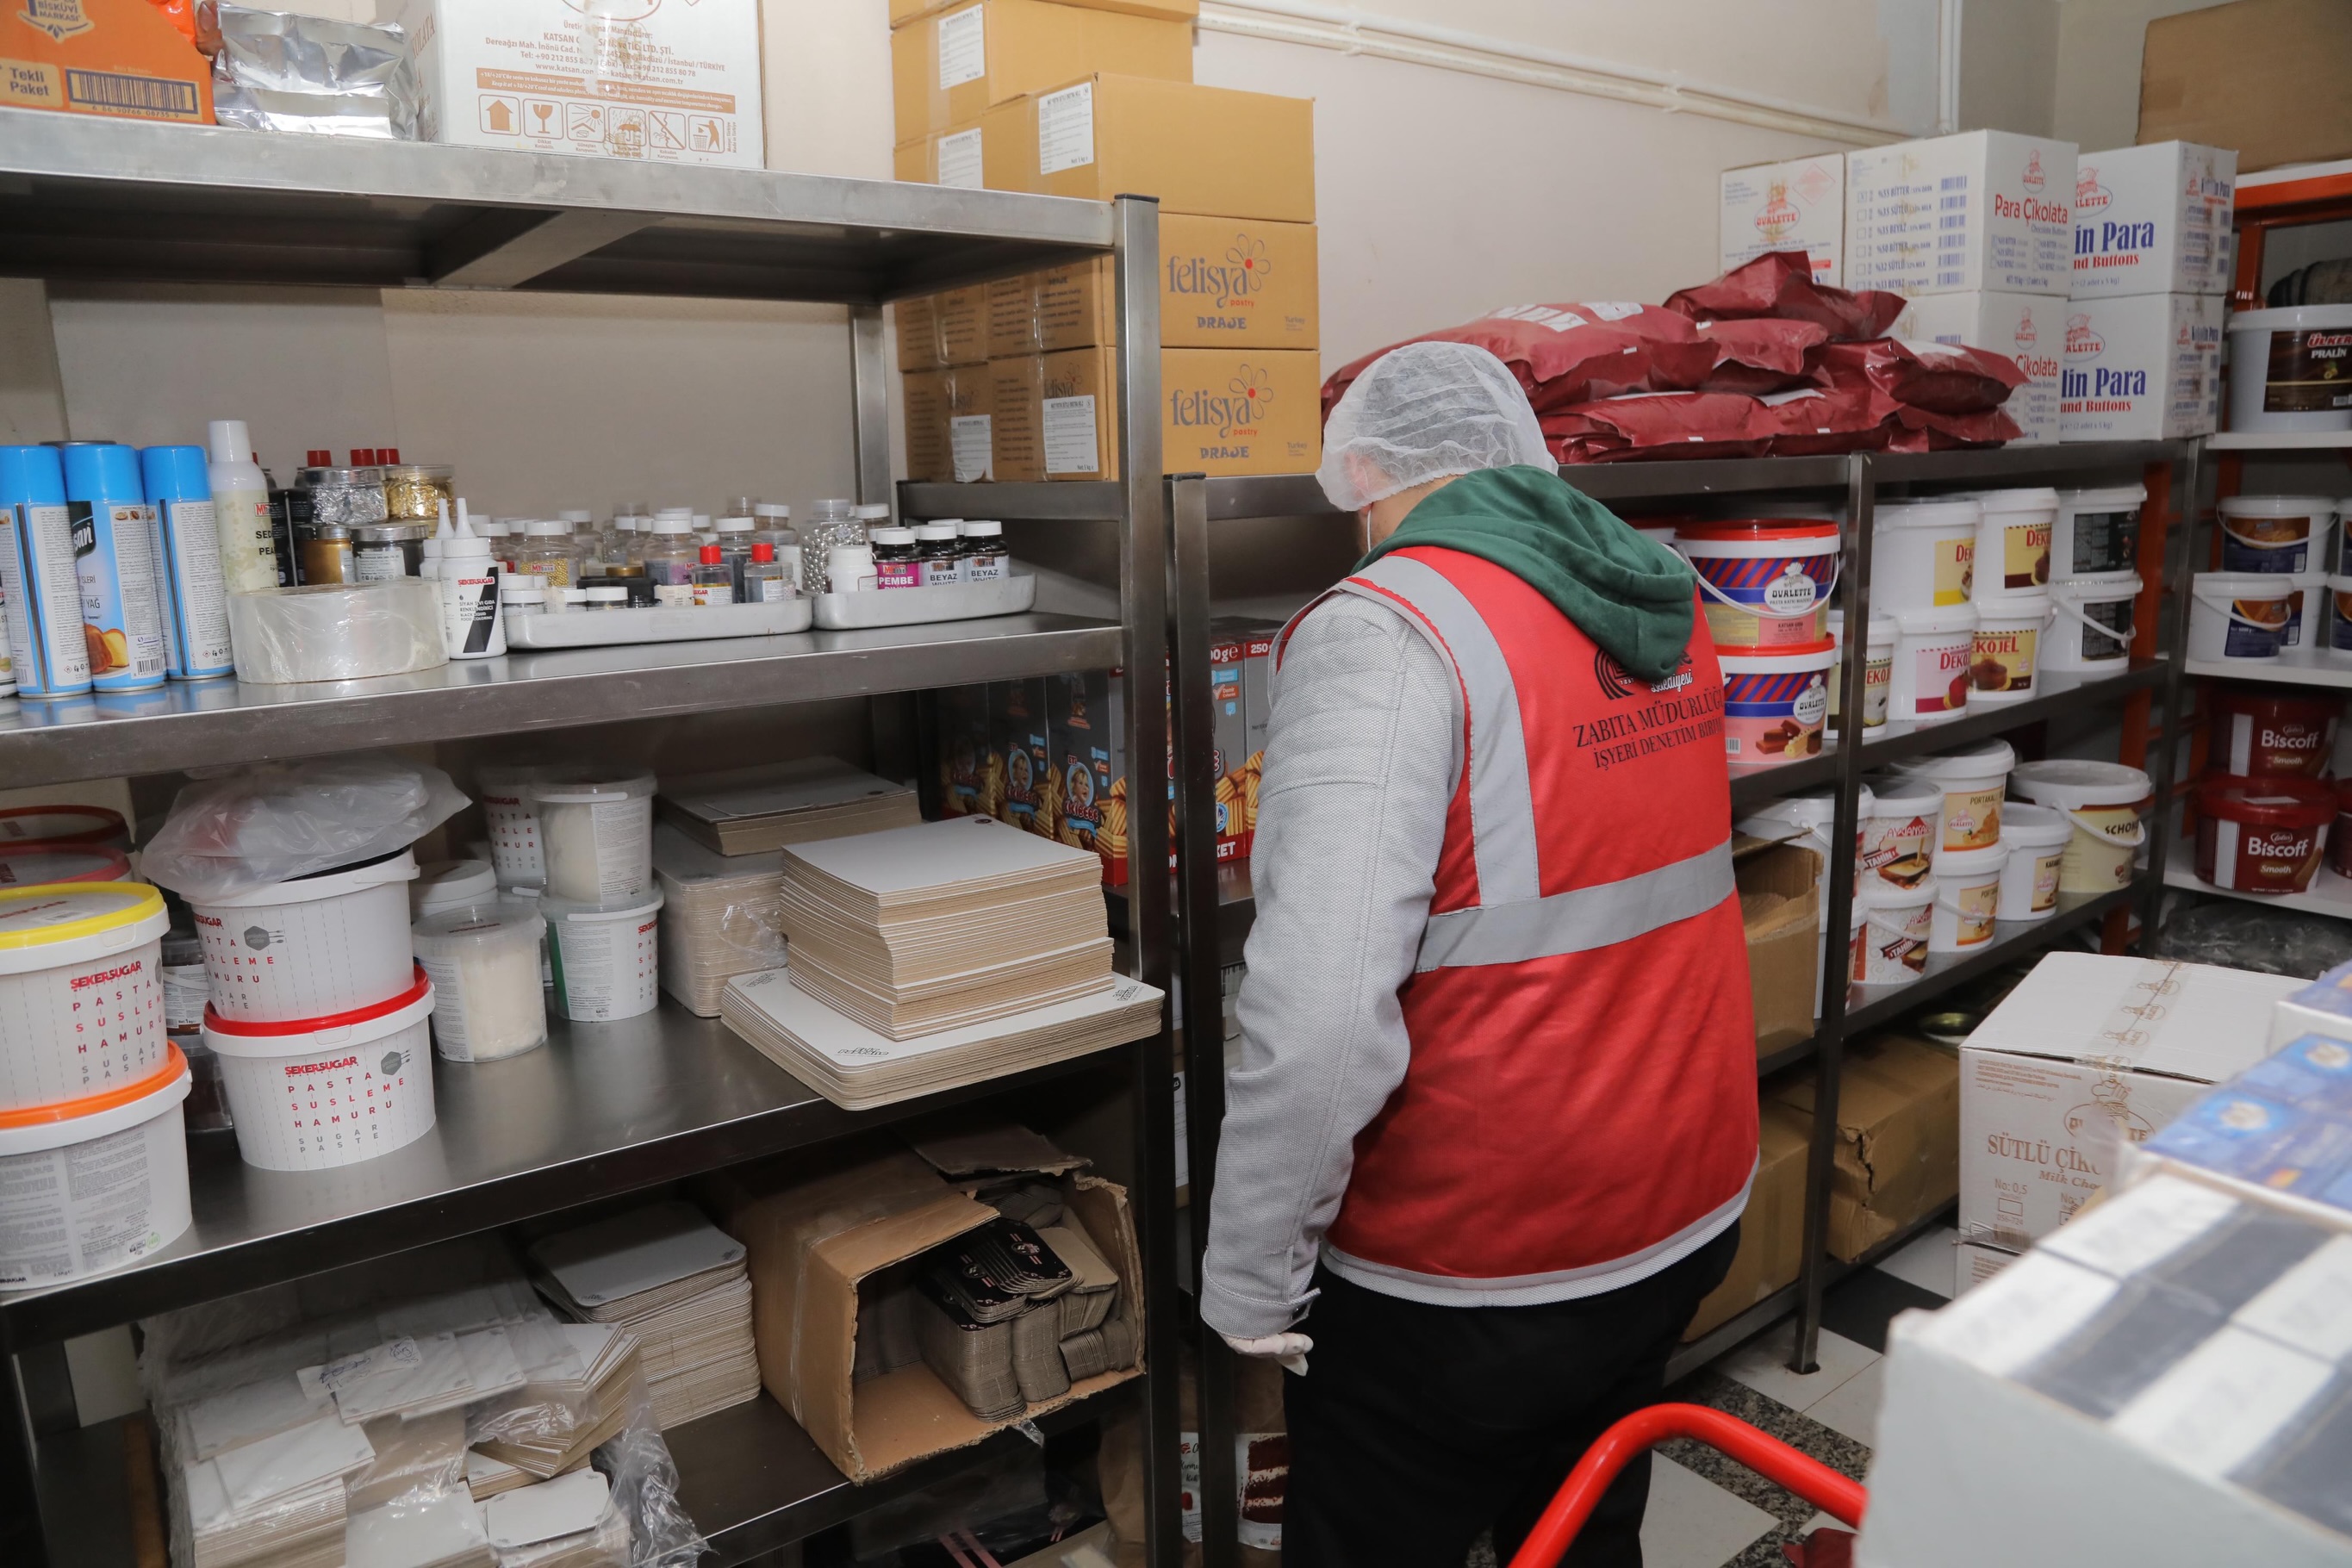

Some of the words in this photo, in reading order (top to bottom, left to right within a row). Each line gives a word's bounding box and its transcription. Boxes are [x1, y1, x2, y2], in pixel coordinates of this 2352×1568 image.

[544, 32, 575, 44] KATSAN
[486, 37, 517, 49] Dereağzı
[519, 41, 537, 50] Mah.
[538, 41, 559, 52] İnönü
[668, 56, 695, 68] İstanbul
[700, 60, 725, 72] TÜRKİYE
[520, 51, 533, 59] Tel:
[9, 67, 45, 83] Tekli
[10, 83, 49, 96] Paket
[1889, 185, 1910, 197] BİTTER
[2075, 196, 2108, 208] LETTE
[1891, 203, 1909, 215] SÜTLÜ
[1995, 194, 2020, 219] Para
[2023, 197, 2069, 227] Çikolata
[1757, 213, 1796, 226] OVALETTE
[1889, 222, 1907, 233] BEYAZ
[2102, 221, 2155, 252] Para
[1888, 240, 1908, 252] BİTTER
[1888, 258, 1905, 271] SÜTLÜ
[2093, 253, 2140, 269] Buttons
[1167, 256, 1248, 309] felisya
[1886, 277, 1905, 289] BEYAZ
[1230, 299, 1255, 308] pastry
[1197, 316, 1248, 330] DRAJE
[2066, 341, 2100, 353] ALETTE
[2307, 333, 2352, 348] ÜLKER
[2311, 347, 2347, 359] PRALİN
[2095, 367, 2146, 396] Para
[2086, 401, 2131, 413] Buttons
[1170, 389, 1250, 439] felisya
[1234, 429, 1258, 438] pastry
[1200, 446, 1249, 459] DRAJE
[930, 573, 957, 582] BEYAZ
[971, 569, 999, 577] BEYAZ
[879, 576, 913, 585] PEMBE
[1772, 588, 1811, 599] OVALETTE
[1972, 637, 2019, 653] EKOJEL
[1799, 699, 1825, 710] OVALETTE
[1573, 713, 1638, 748] ZABITA
[2261, 729, 2318, 749] Biscoff
[1593, 738, 1638, 771] İŞYERİ
[1640, 724, 1696, 756] DENETİM
[2273, 756, 2303, 764] Smooth
[2248, 837, 2309, 856] Biscoff
[1867, 851, 1893, 868] TAHİN
[2261, 865, 2292, 874] Smooth
[1892, 939, 1915, 957] TAHİN
[208, 968, 259, 983] AMURU
[72, 980, 152, 1012] PASTA
[288, 1072, 372, 1093] PASTA
[295, 1100, 392, 1128] HAMURU
[299, 1123, 377, 1144] SUGAR
[300, 1132, 379, 1154] PASTE
[1988, 1131, 2050, 1165] SÜTLÜ
[2038, 1170, 2069, 1183] Milk
[1994, 1179, 2010, 1192] No:
[2013, 1182, 2027, 1196] 0,5
[2061, 1192, 2077, 1204] No:
